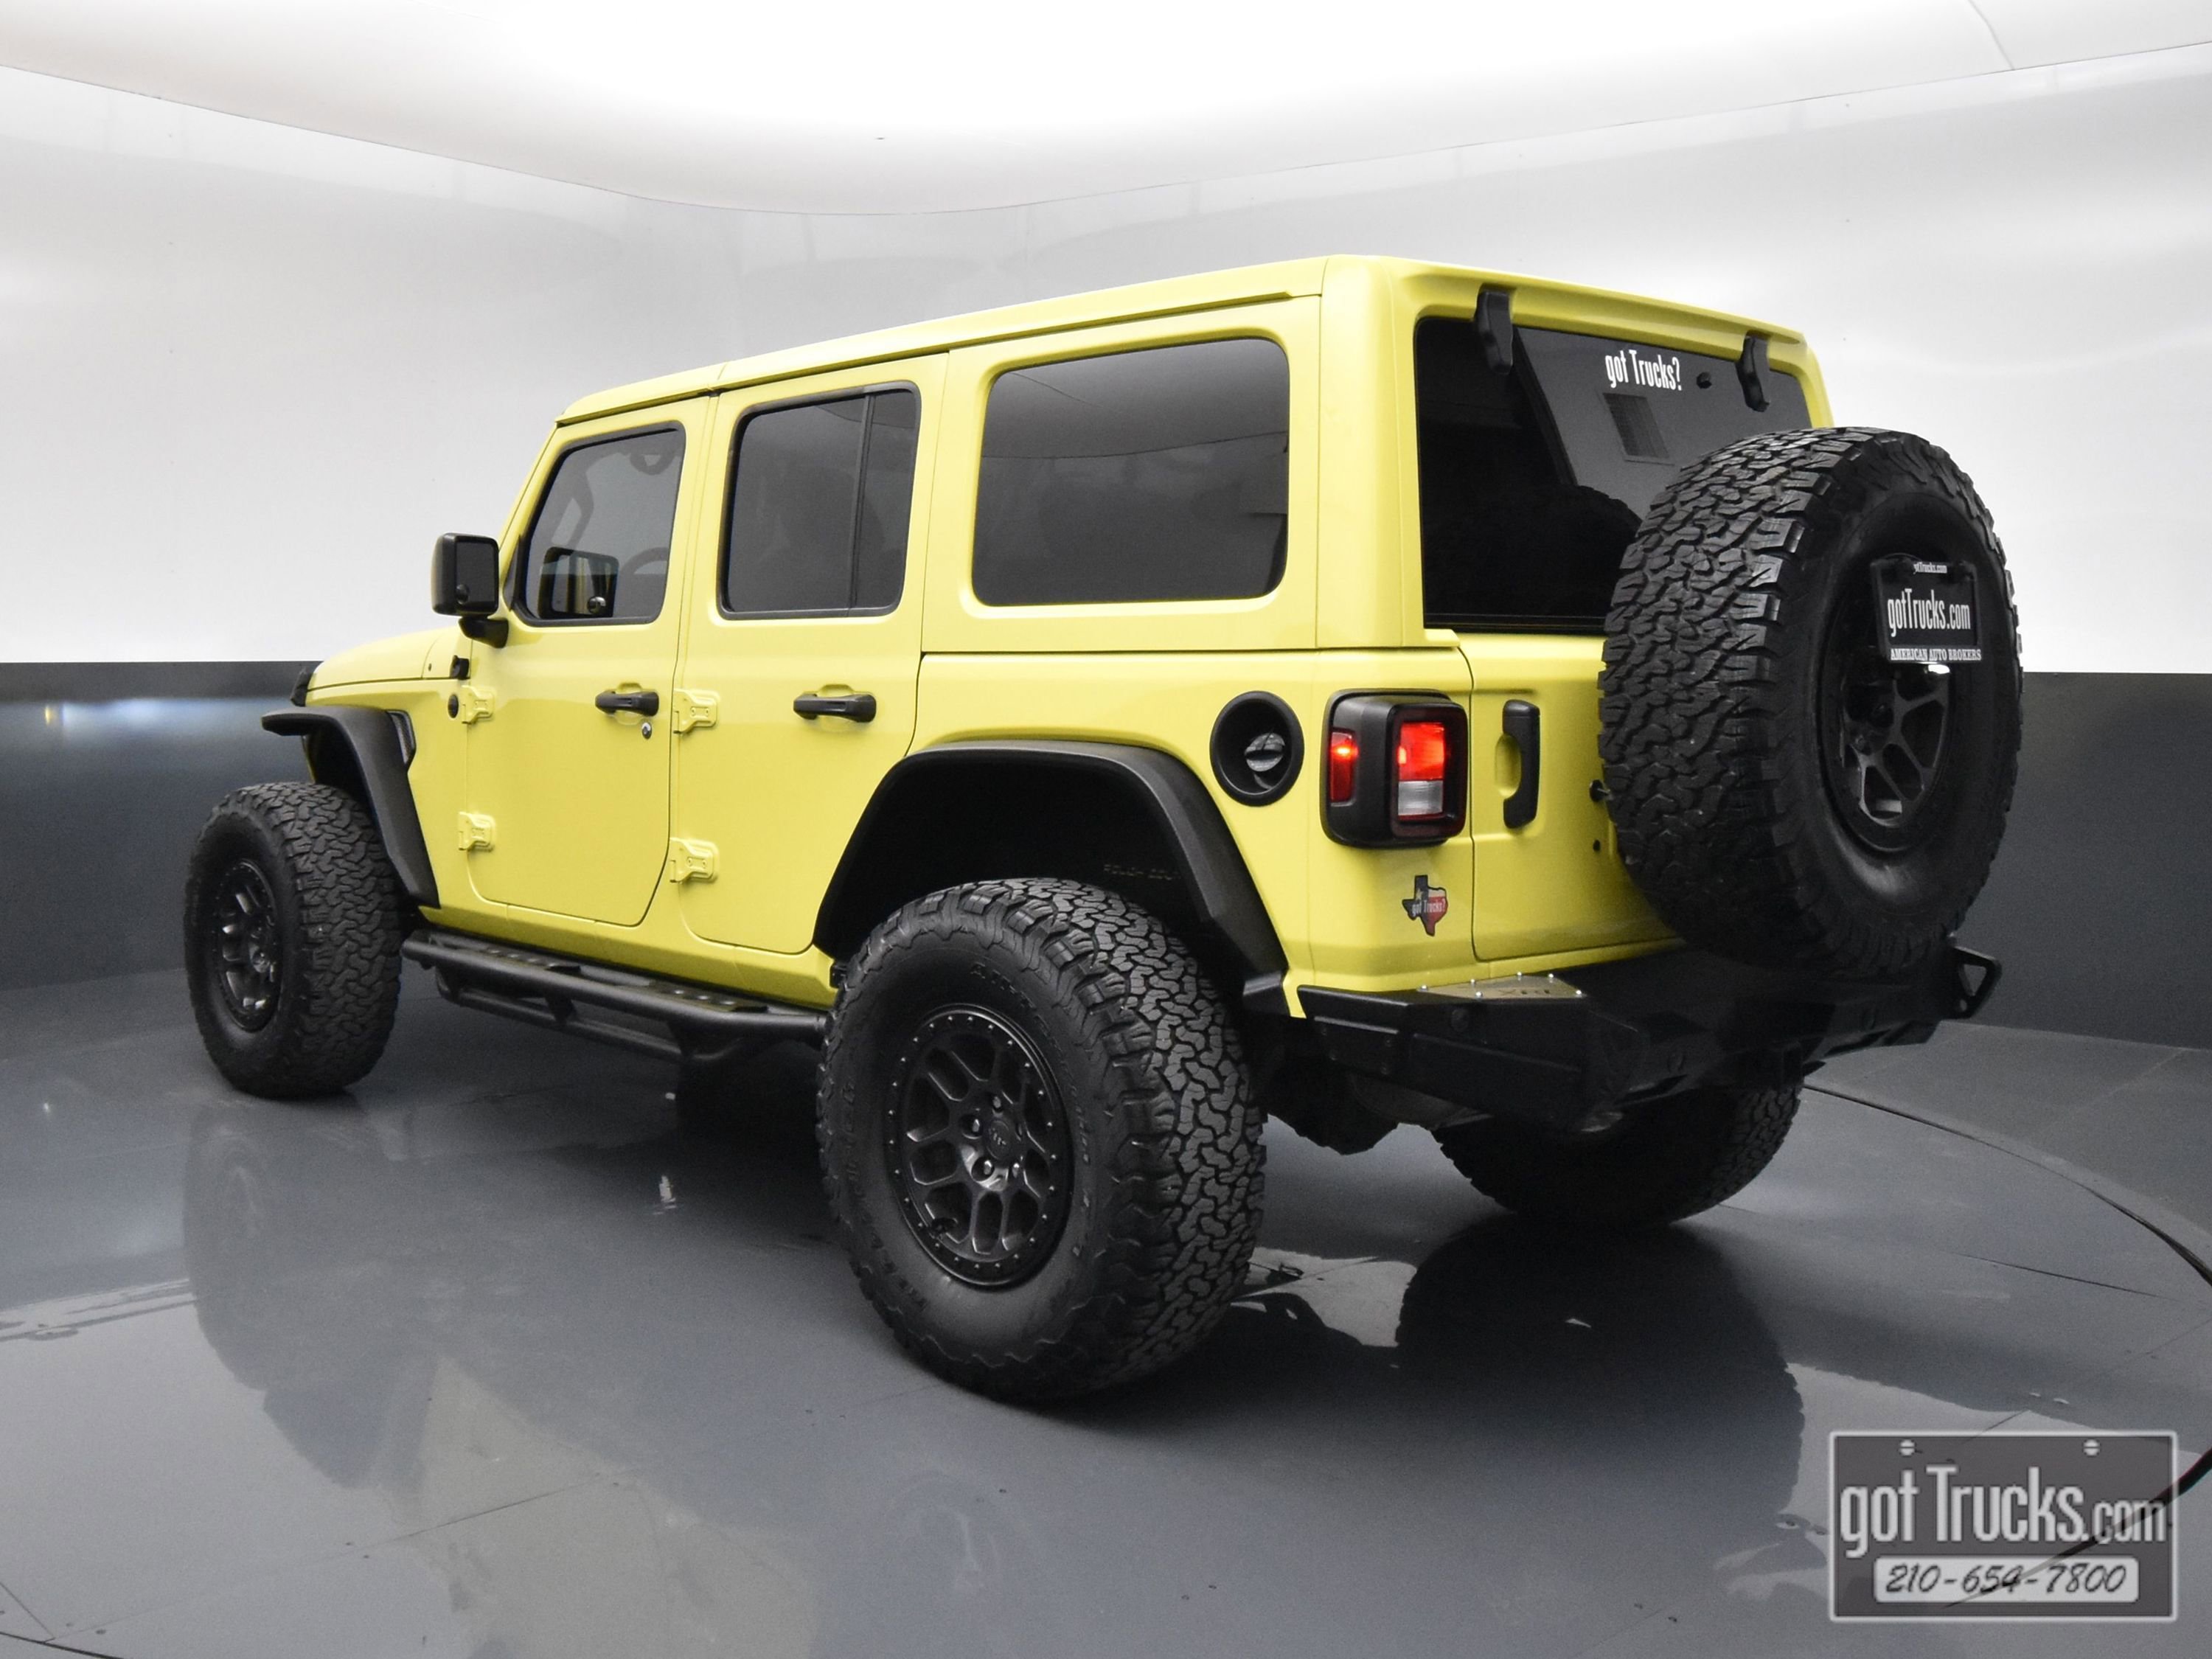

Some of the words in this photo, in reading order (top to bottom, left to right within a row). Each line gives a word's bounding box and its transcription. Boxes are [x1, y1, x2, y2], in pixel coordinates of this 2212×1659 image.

[1604, 349, 1629, 389] got
[1629, 349, 1682, 391] Trucks?
[1888, 588, 1971, 637] gotTrucks.com
[1891, 648, 1928, 661] AMERICAN
[1929, 649, 1947, 661] AUTO
[1949, 649, 1982, 661] BROKERS
[1412, 900, 1422, 917] got
